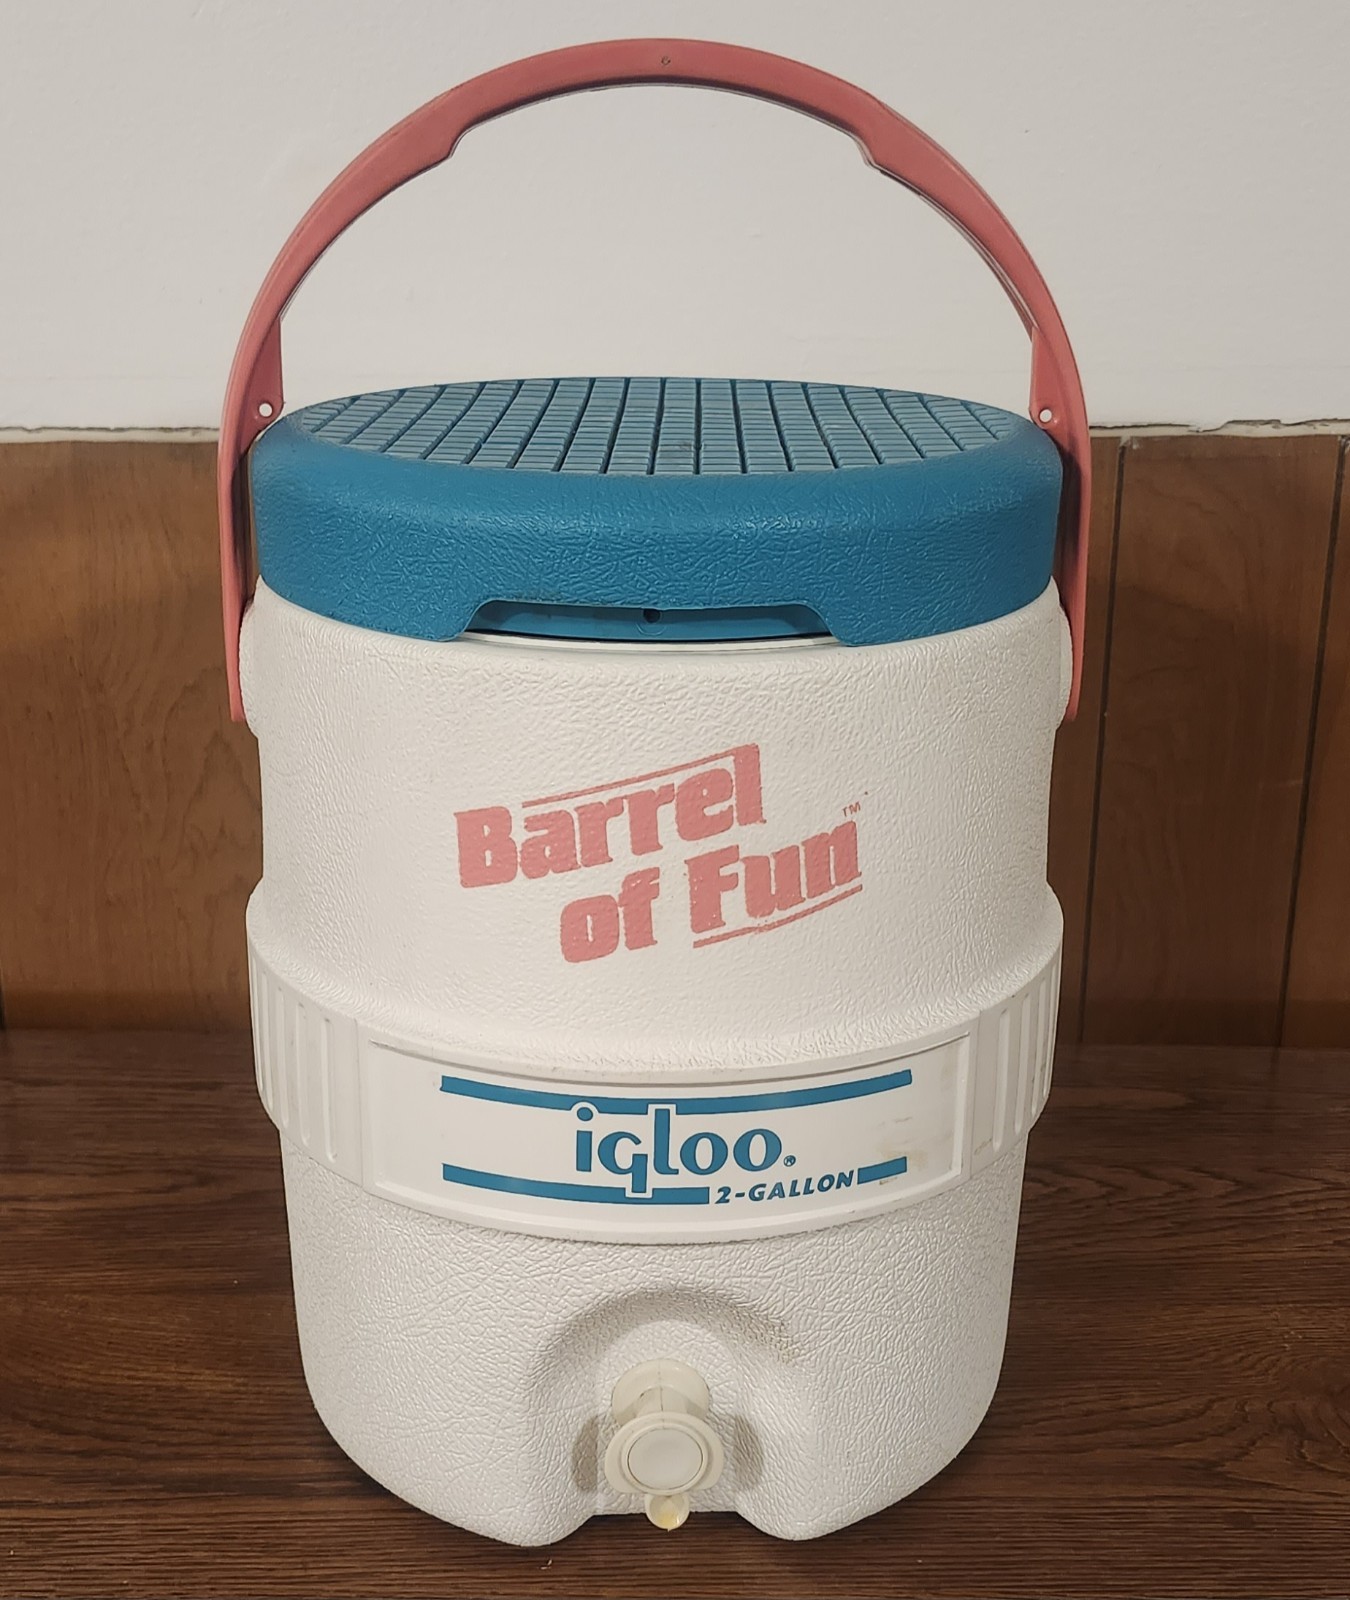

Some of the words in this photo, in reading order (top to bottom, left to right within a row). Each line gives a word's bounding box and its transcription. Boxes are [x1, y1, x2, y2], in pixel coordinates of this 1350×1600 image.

[453, 743, 767, 888] Barrel
[560, 866, 660, 963] of
[684, 820, 862, 934] Fun
[715, 1170, 854, 1204] 2-GALLON
